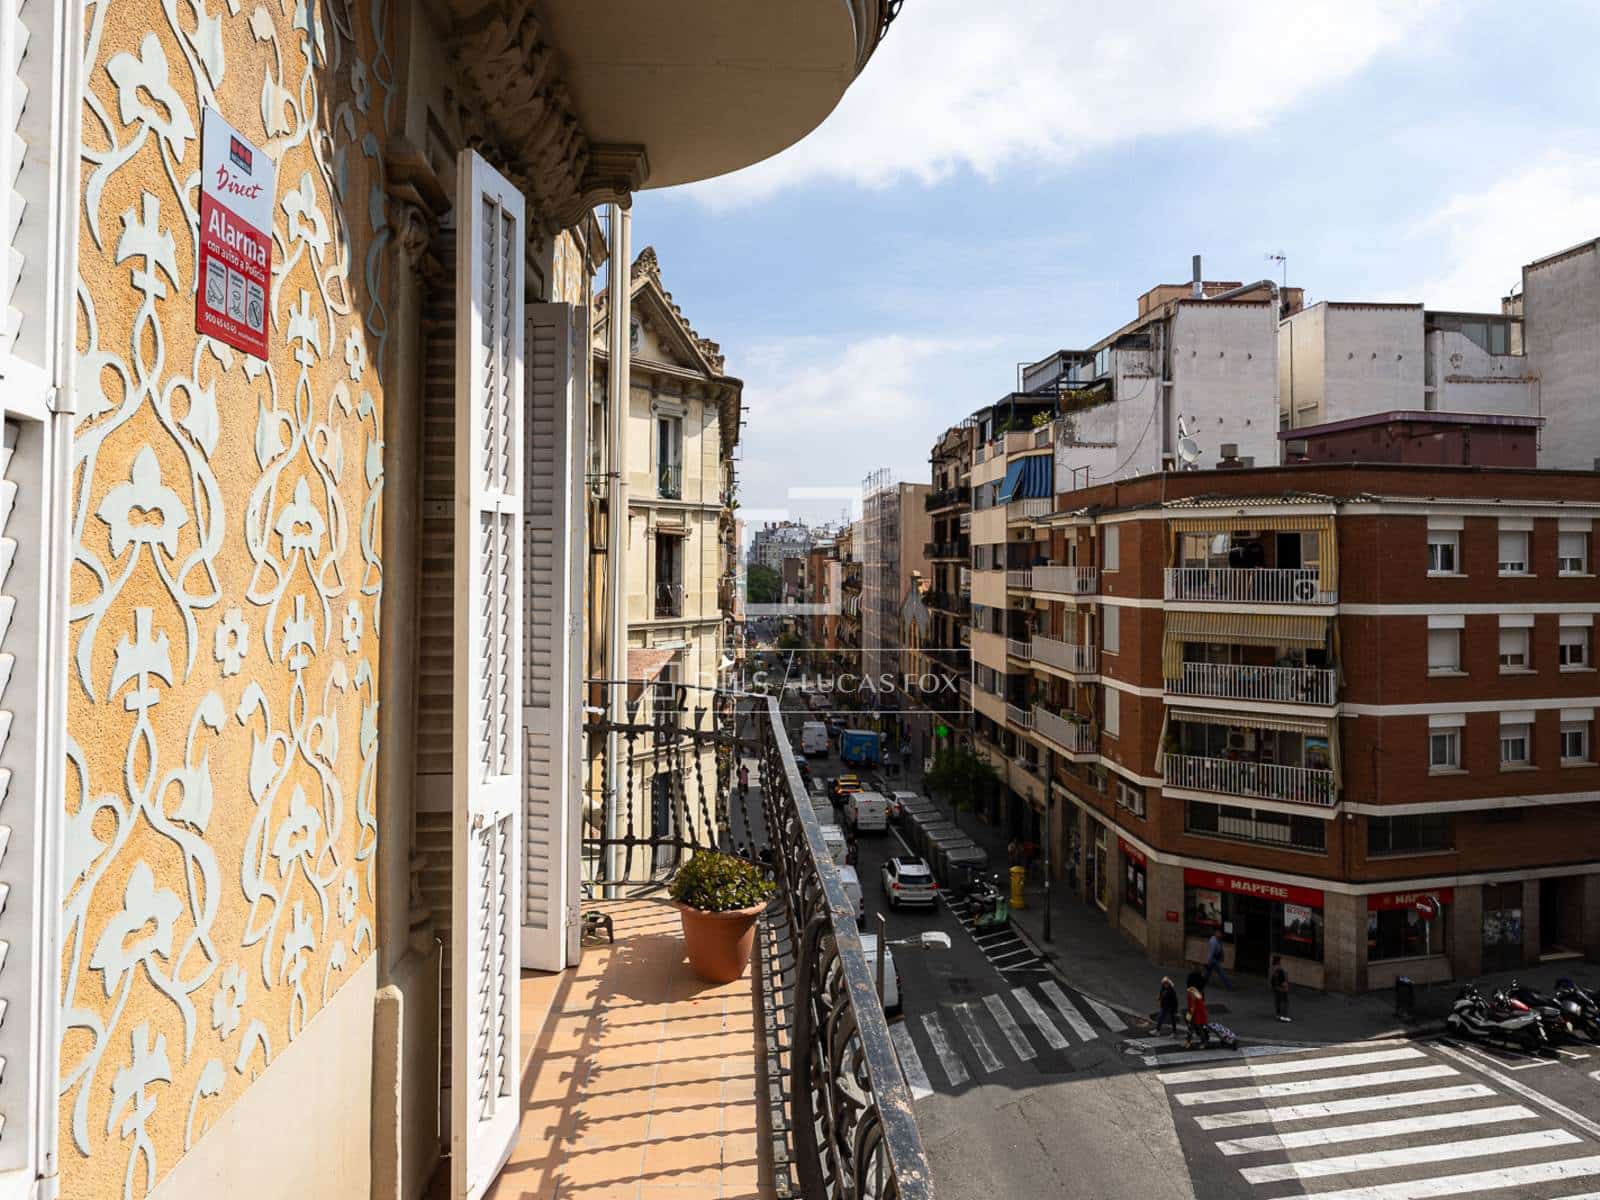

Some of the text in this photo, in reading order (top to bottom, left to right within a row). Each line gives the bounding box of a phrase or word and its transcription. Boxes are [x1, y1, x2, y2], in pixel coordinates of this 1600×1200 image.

[216, 163, 264, 200] Direct
[207, 207, 267, 268] Alarma
[1230, 879, 1289, 898] MAPFRE
